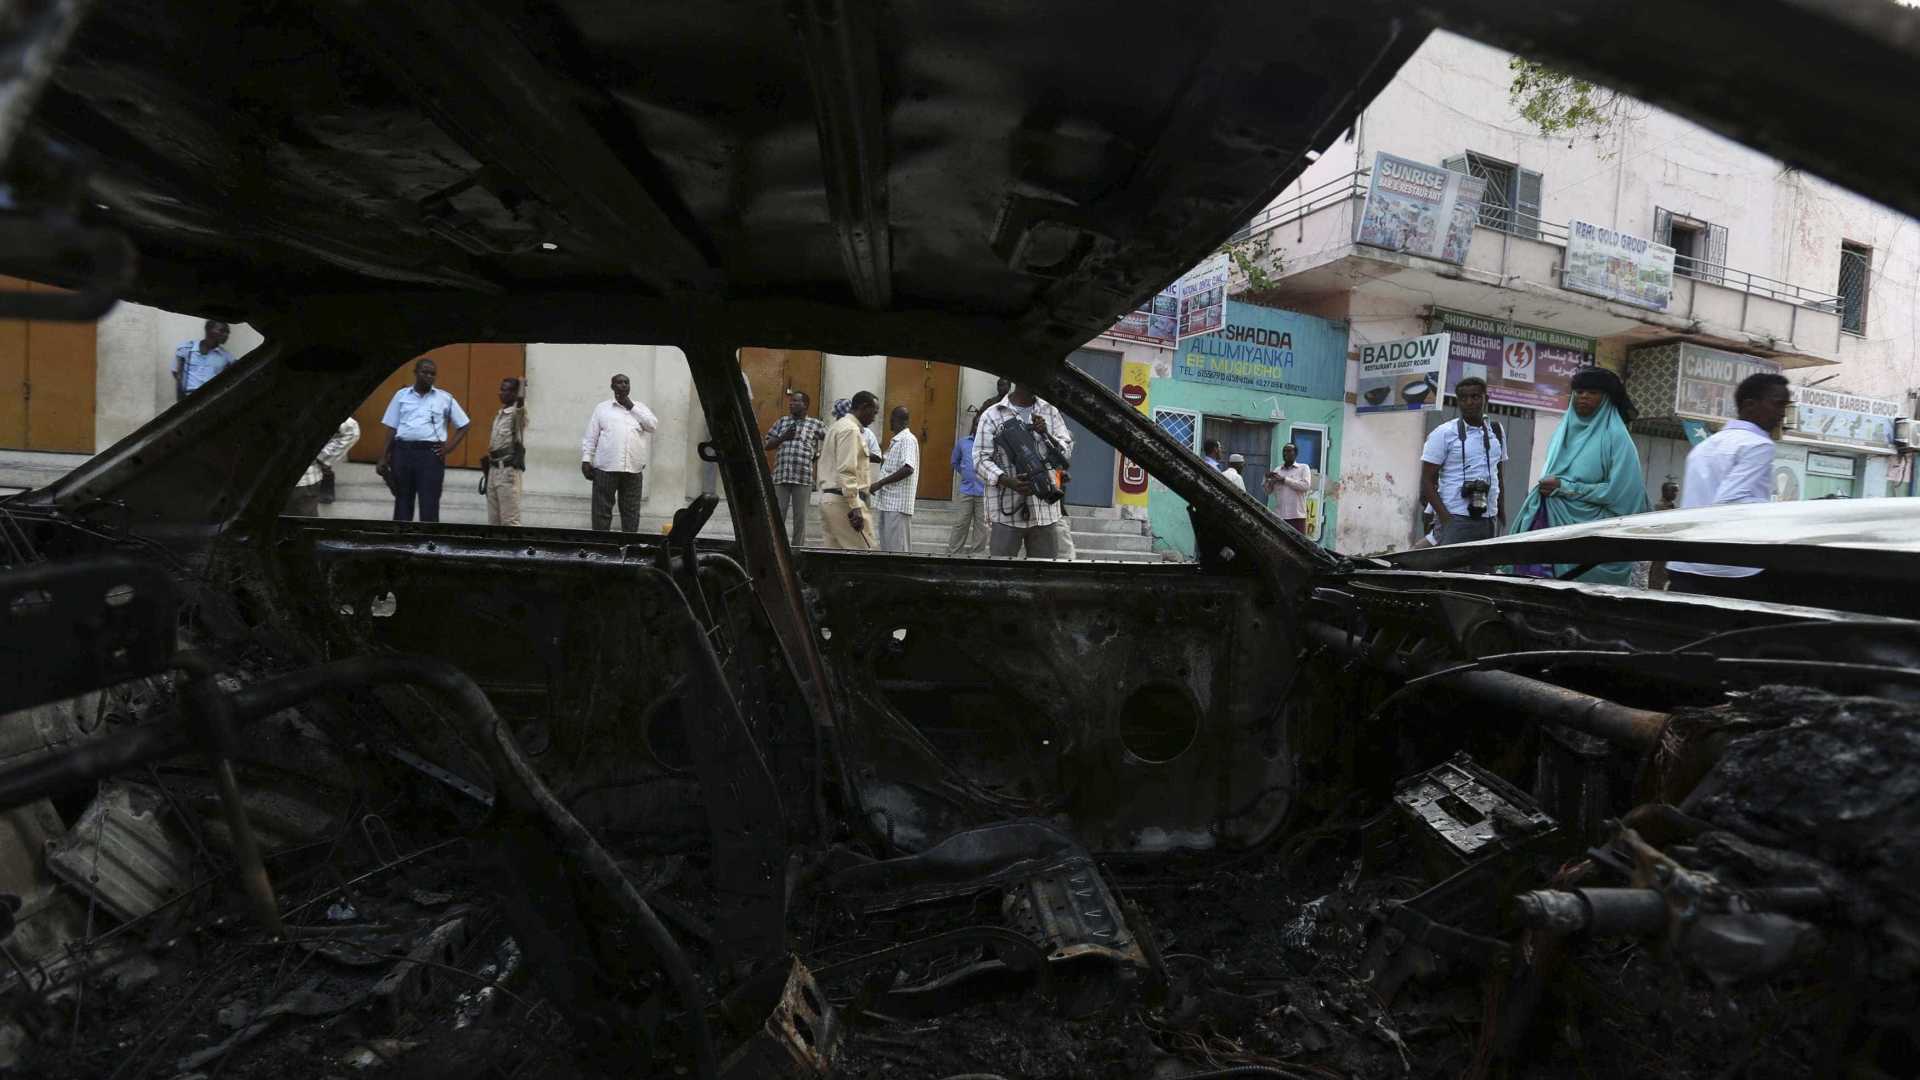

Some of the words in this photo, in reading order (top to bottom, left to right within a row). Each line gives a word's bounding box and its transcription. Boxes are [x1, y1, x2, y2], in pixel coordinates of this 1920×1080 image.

[1382, 161, 1443, 190] SUNRISE
[1400, 183, 1442, 201] RESTAURANT
[1575, 221, 1596, 242] REAL
[1599, 228, 1619, 248] GOLD
[1621, 234, 1648, 254] GROUP
[1443, 312, 1495, 334] SHIRKADDA
[1496, 321, 1548, 343] KORONTADA
[1190, 338, 1295, 369] ALLUMIYANKA
[1363, 338, 1440, 365] BADOW
[1451, 344, 1486, 361] COMPANY
[1469, 334, 1501, 350] ELECTRIC
[1185, 352, 1207, 368] EE
[1364, 363, 1393, 371] RESTAURANT
[1398, 360, 1413, 368] GUEST
[1686, 355, 1733, 381] CARWO
[1801, 389, 1838, 409] MODERN
[1839, 395, 1871, 414] BARBER
[1871, 401, 1899, 417] GROUP
